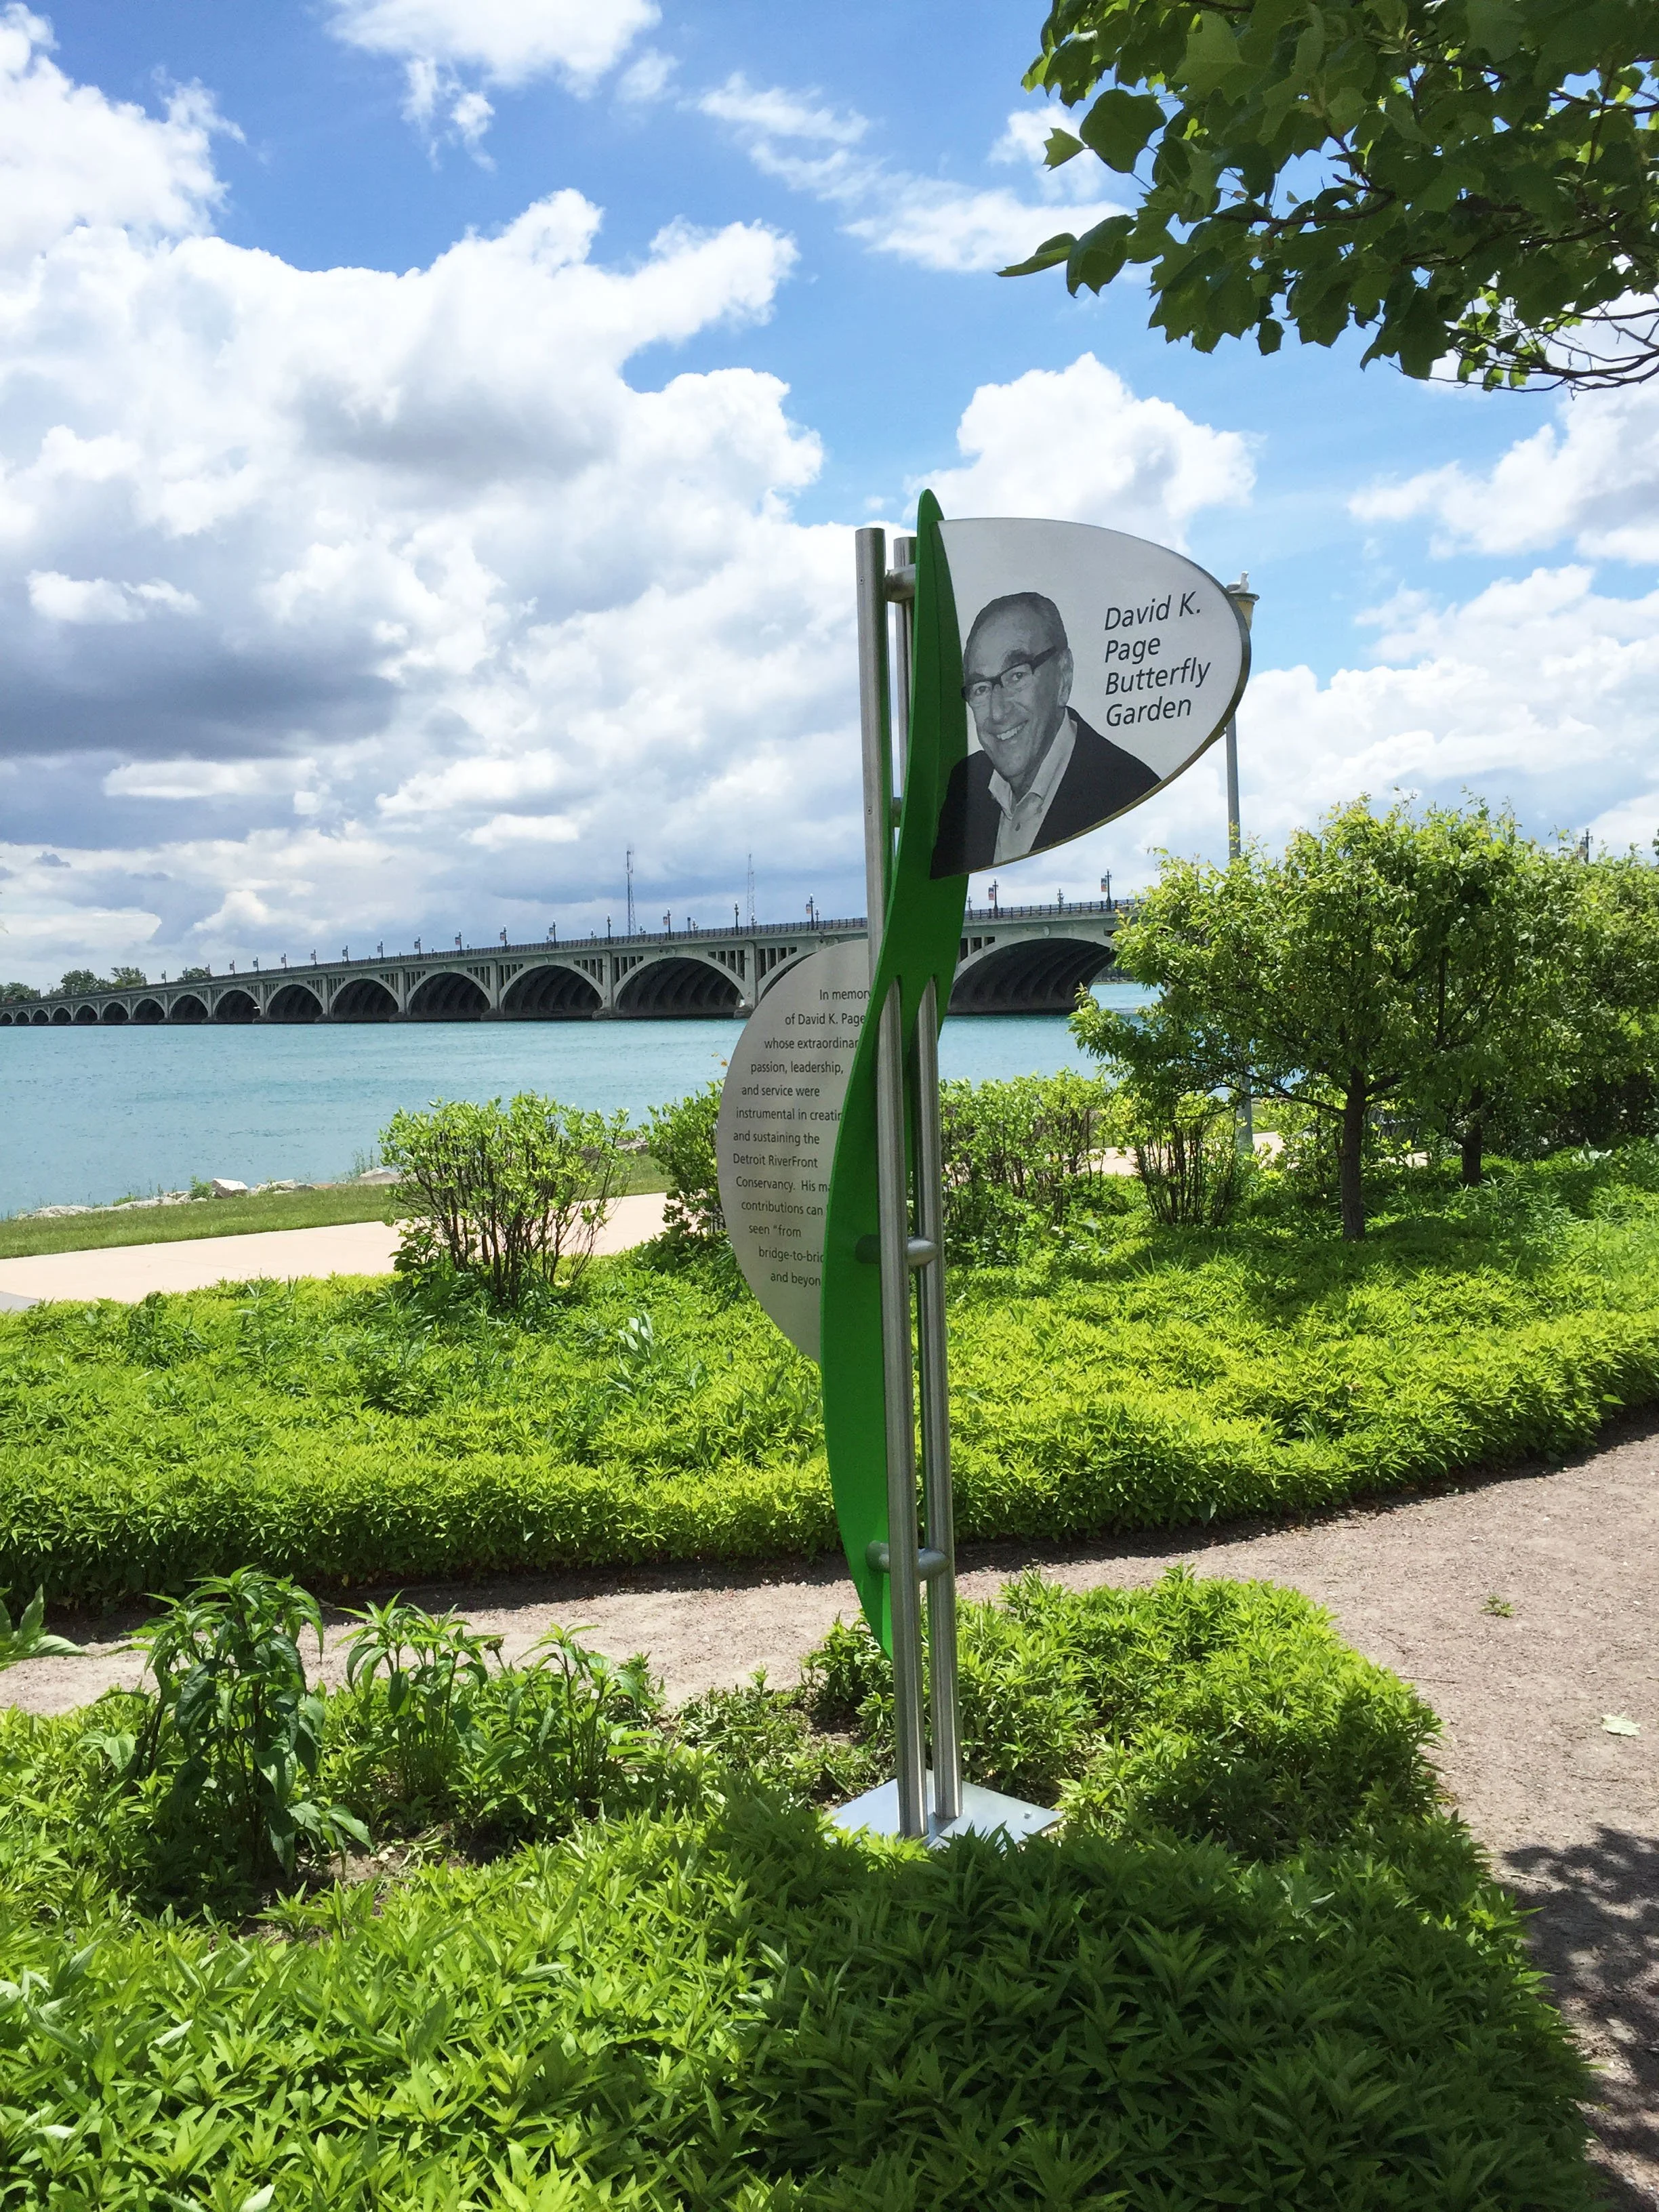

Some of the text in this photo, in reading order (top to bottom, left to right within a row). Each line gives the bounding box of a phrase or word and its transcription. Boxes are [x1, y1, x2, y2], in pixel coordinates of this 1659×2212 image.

[1105, 591, 1201, 630] David K.
[1105, 637, 1161, 665] Page
[1105, 657, 1211, 695] Butterfly
[1106, 696, 1191, 726] Garden
[819, 989, 828, 1000] In
[785, 1013, 865, 1027] of David K. Page
[764, 1038, 794, 1049] whose
[751, 1061, 844, 1075] passion, leadership,
[742, 1085, 820, 1097] and service were
[736, 1107, 794, 1120] instrumental
[798, 1109, 806, 1120] in
[734, 1130, 820, 1146] and sustaining the
[733, 1153, 818, 1168] Detroit RiverFront
[736, 1176, 795, 1193] Conservancy.
[802, 1181, 815, 1192] His
[741, 1200, 823, 1216] contributions can
[749, 1225, 802, 1237] seen "from
[771, 1272, 787, 1283] and
